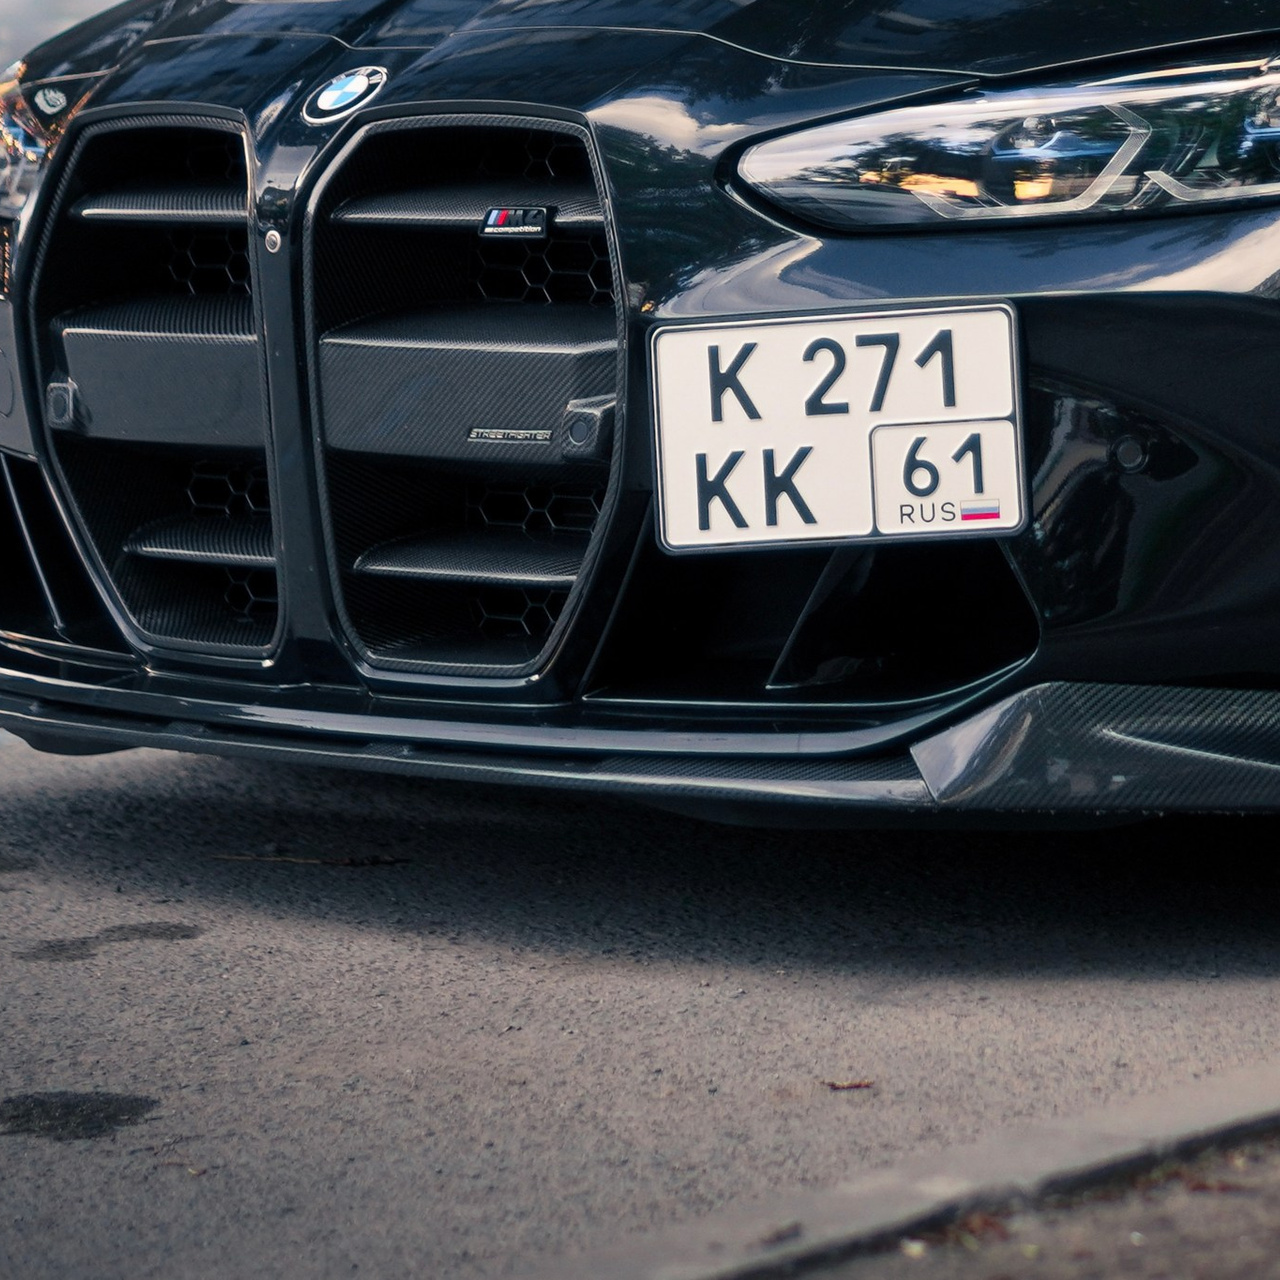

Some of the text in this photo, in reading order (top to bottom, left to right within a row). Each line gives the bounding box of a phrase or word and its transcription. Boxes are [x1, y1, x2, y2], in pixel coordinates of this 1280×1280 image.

[707, 329, 957, 422] K 271
[695, 446, 818, 531] KK
[902, 432, 984, 497] 61
[900, 502, 957, 524] RUS
